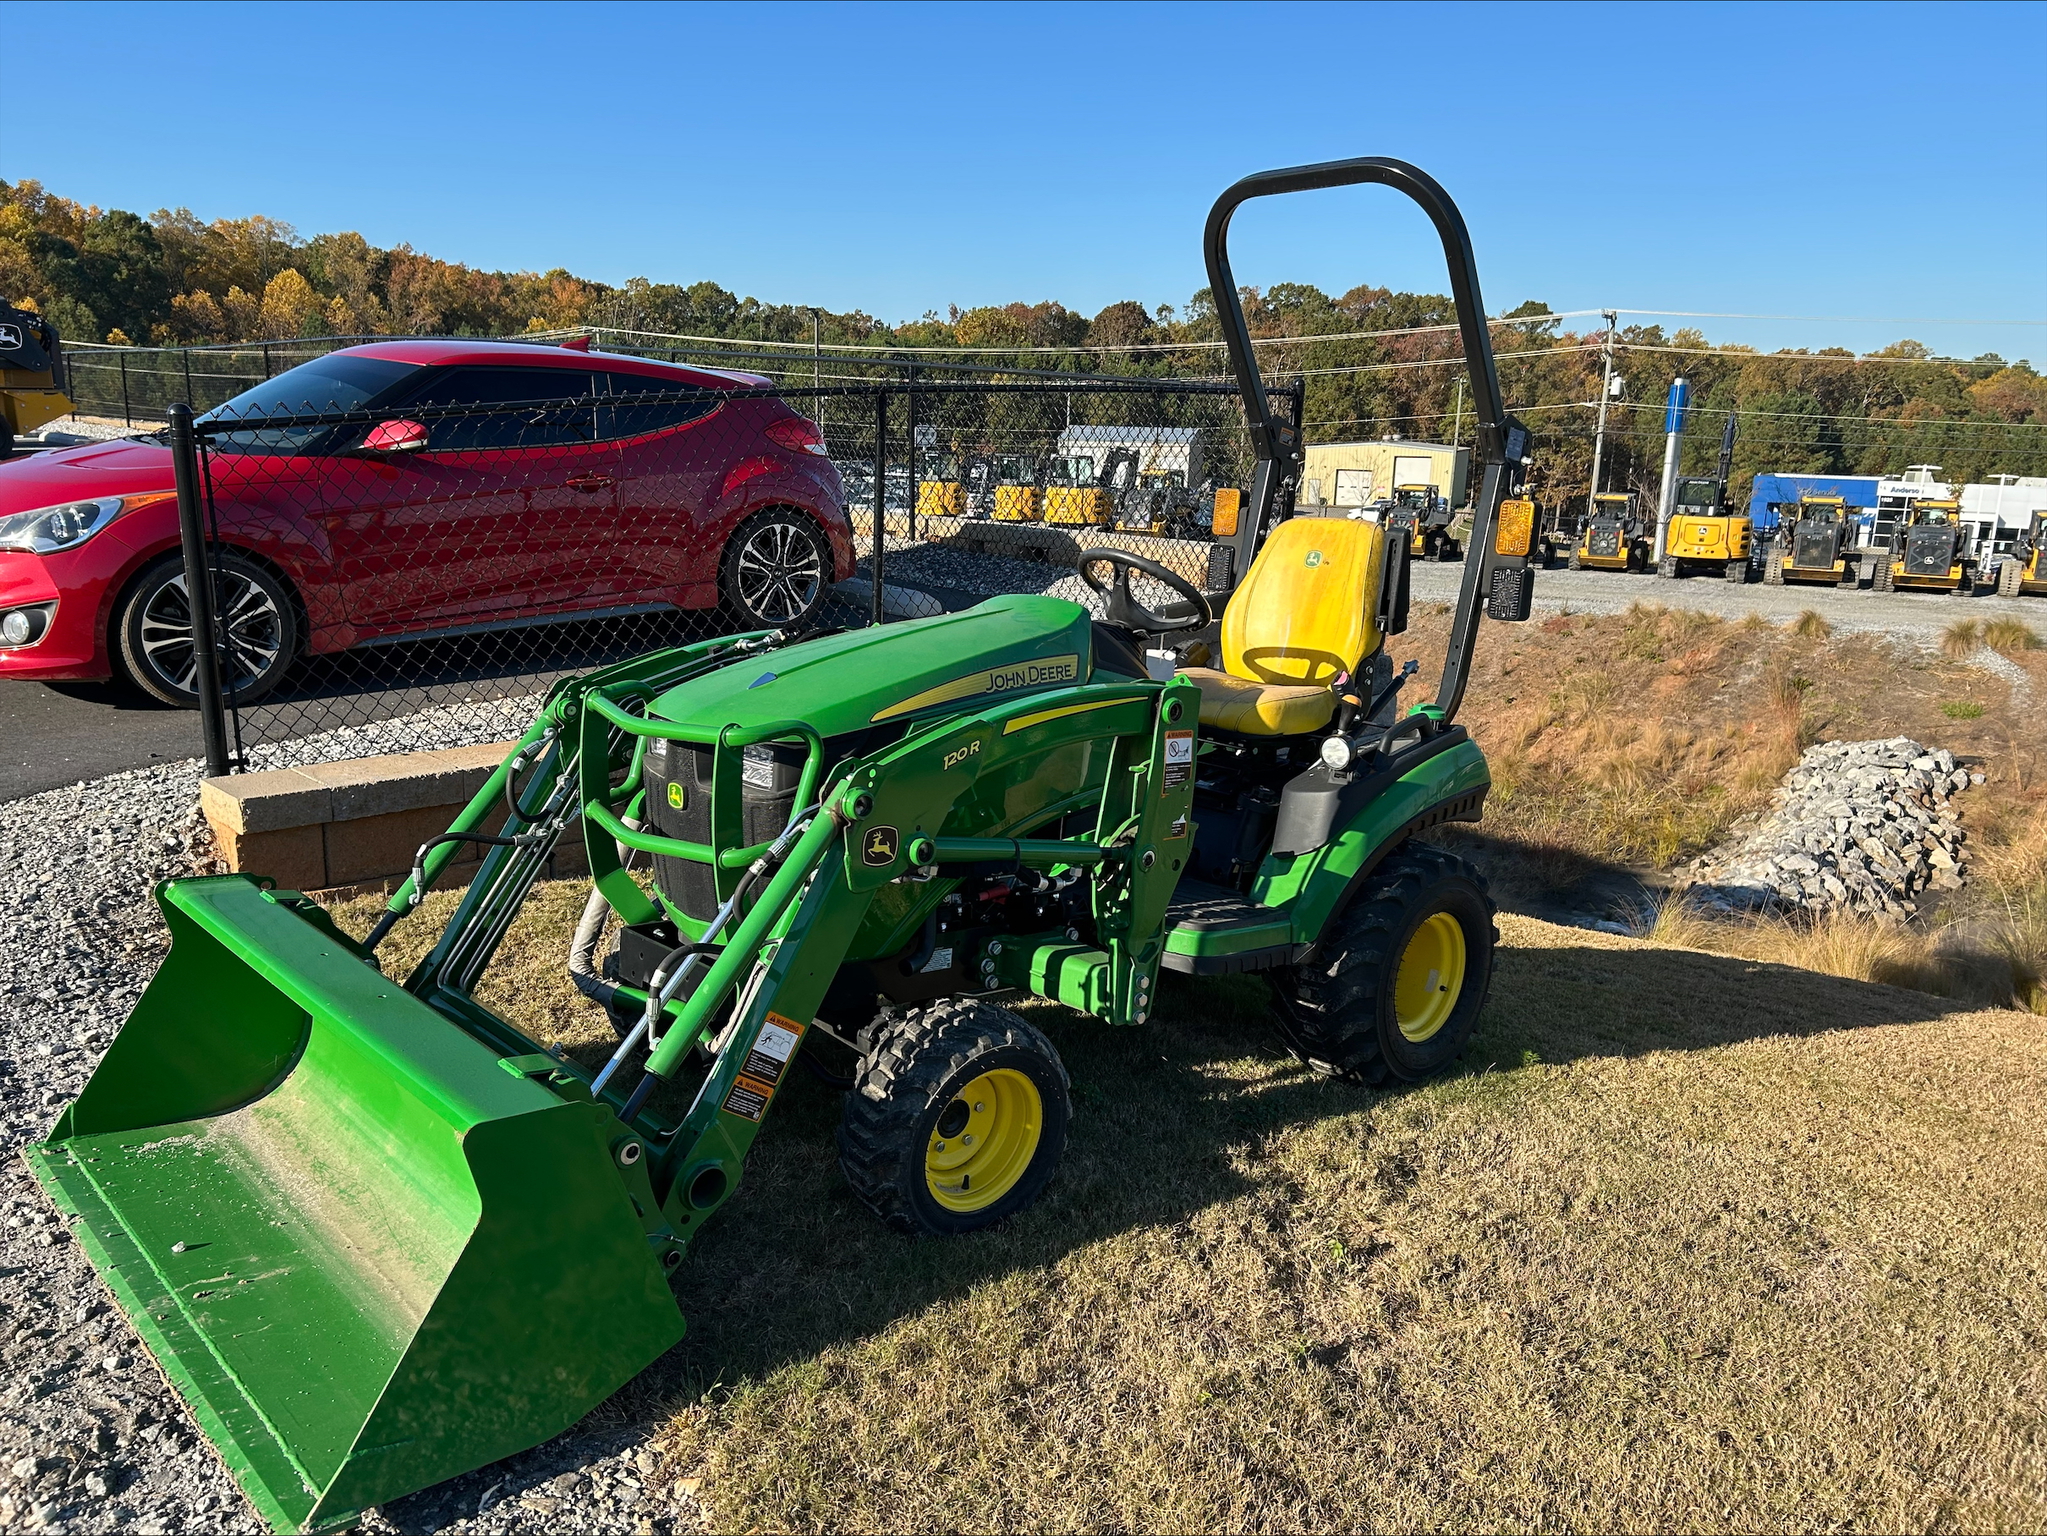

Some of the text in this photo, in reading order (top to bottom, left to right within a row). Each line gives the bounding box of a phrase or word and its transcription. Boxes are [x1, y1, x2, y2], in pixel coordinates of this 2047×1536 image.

[986, 664, 1073, 692] JOHN DEERE
[775, 1017, 800, 1032] WARNING
[744, 1081, 769, 1095] WARNING
